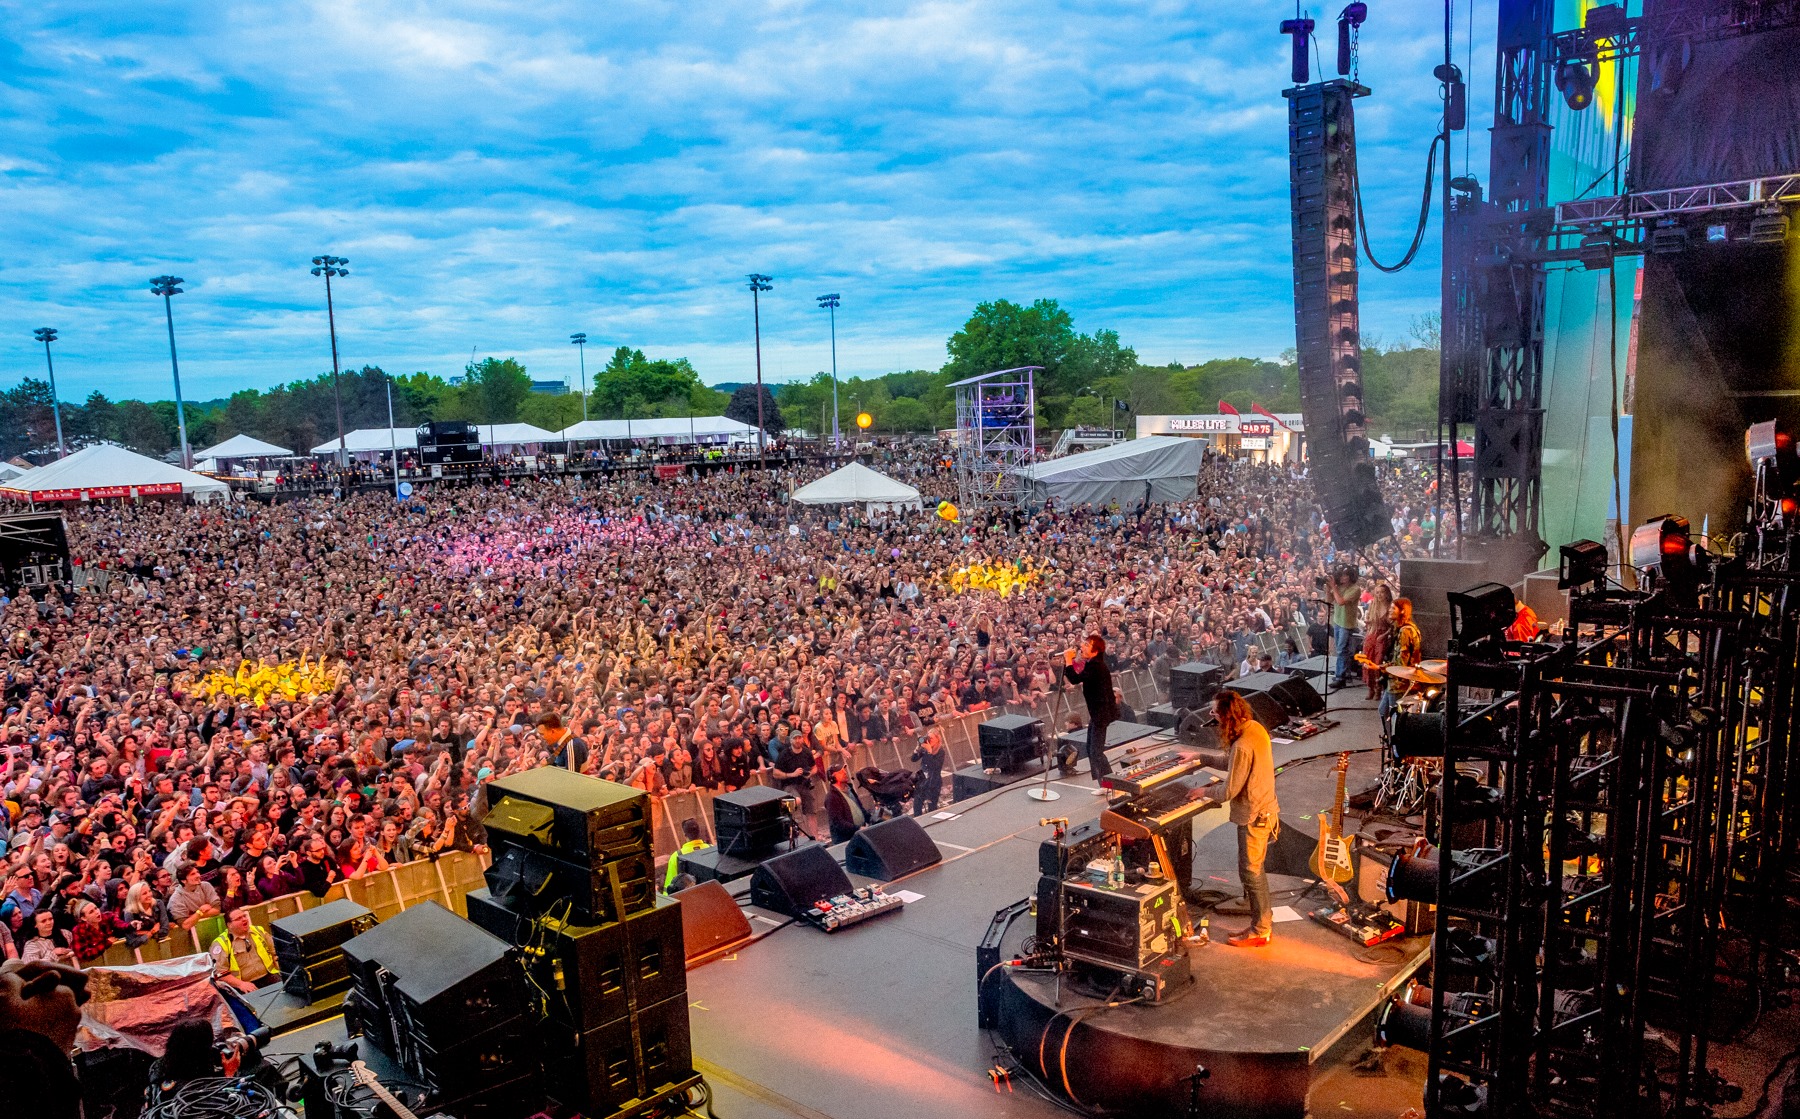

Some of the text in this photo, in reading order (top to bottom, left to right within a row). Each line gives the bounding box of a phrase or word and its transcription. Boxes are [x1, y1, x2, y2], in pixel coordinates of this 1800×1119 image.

[1171, 420, 1226, 429] MILLER LITE
[1242, 424, 1271, 434] BAR 75
